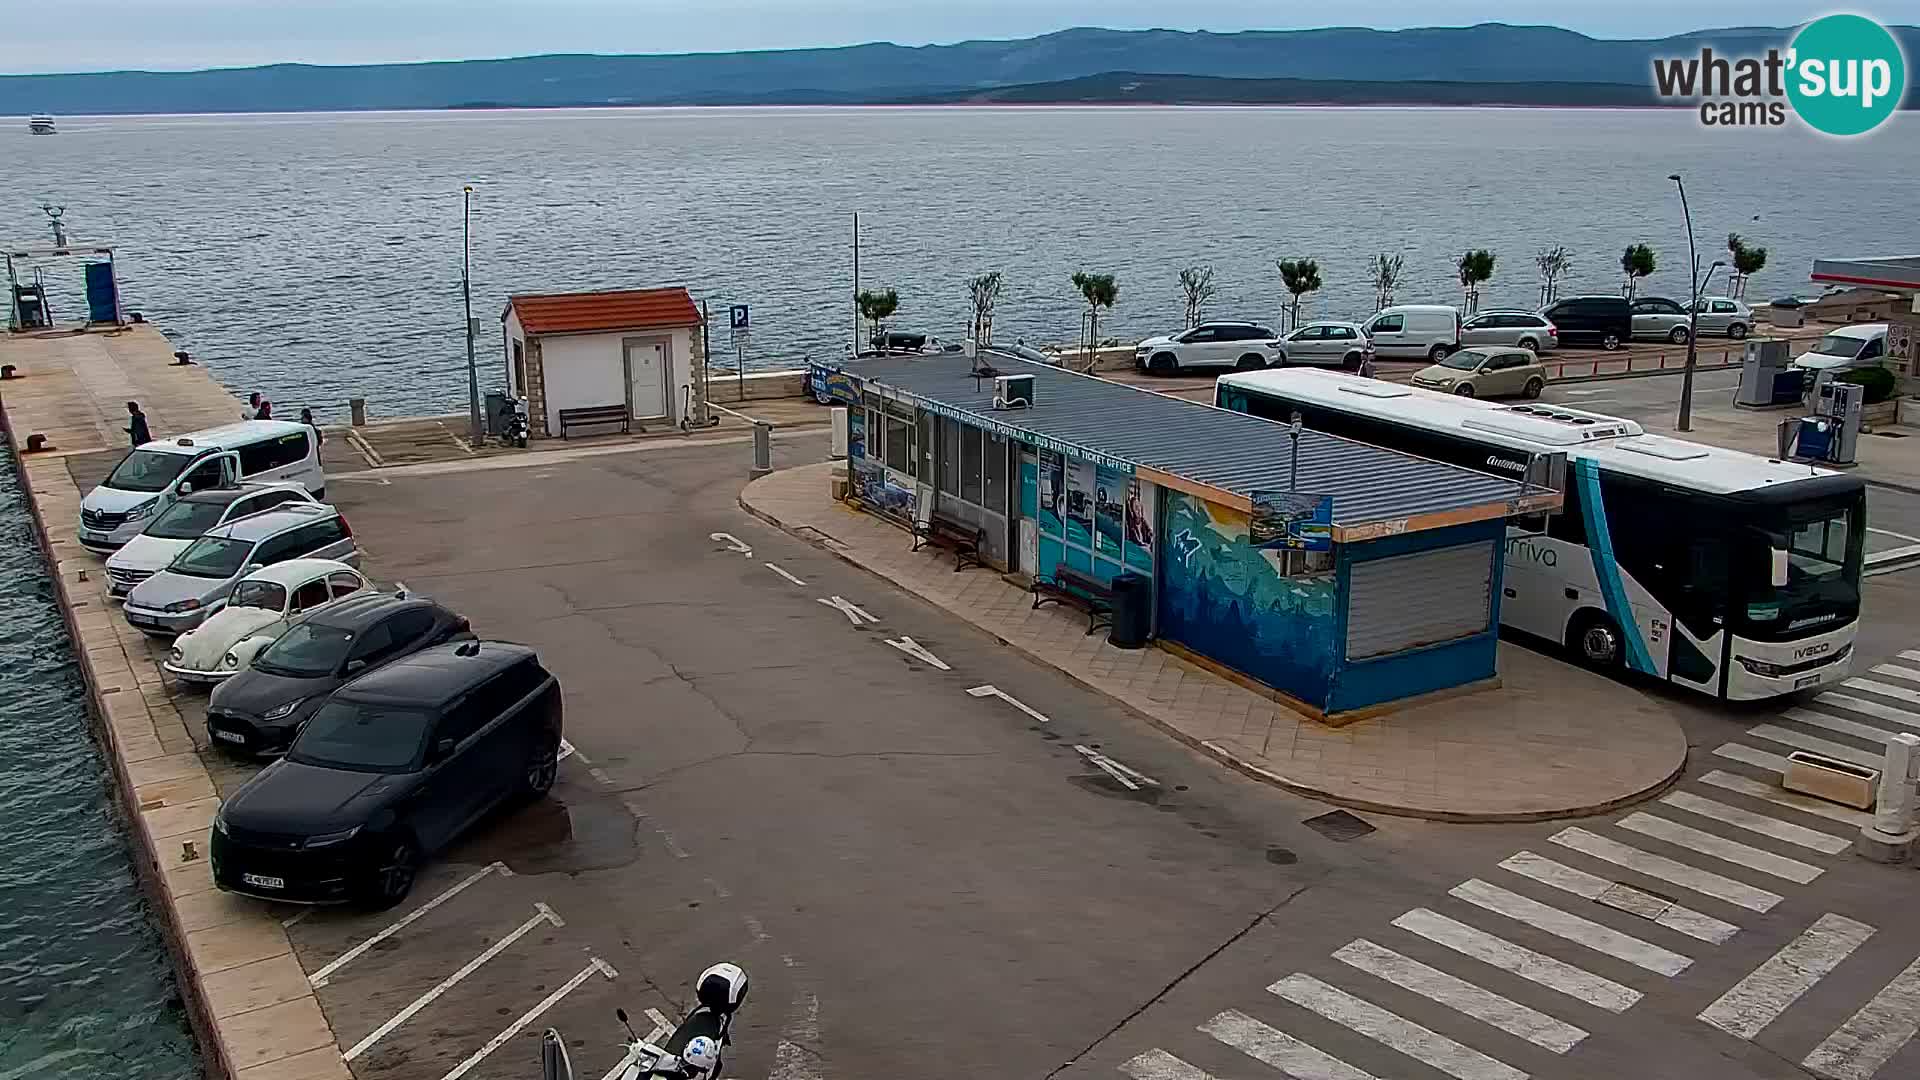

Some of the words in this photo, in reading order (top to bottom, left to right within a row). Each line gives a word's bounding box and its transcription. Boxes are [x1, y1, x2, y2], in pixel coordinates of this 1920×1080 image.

[734, 308, 745, 325] P
[997, 424, 1025, 440] POSTAJA
[1035, 435, 1048, 447] BUS
[1049, 441, 1079, 457] STATION
[1081, 450, 1106, 465] TICKET
[1106, 458, 1132, 473] OFFICE
[1794, 643, 1829, 659] IVECO
